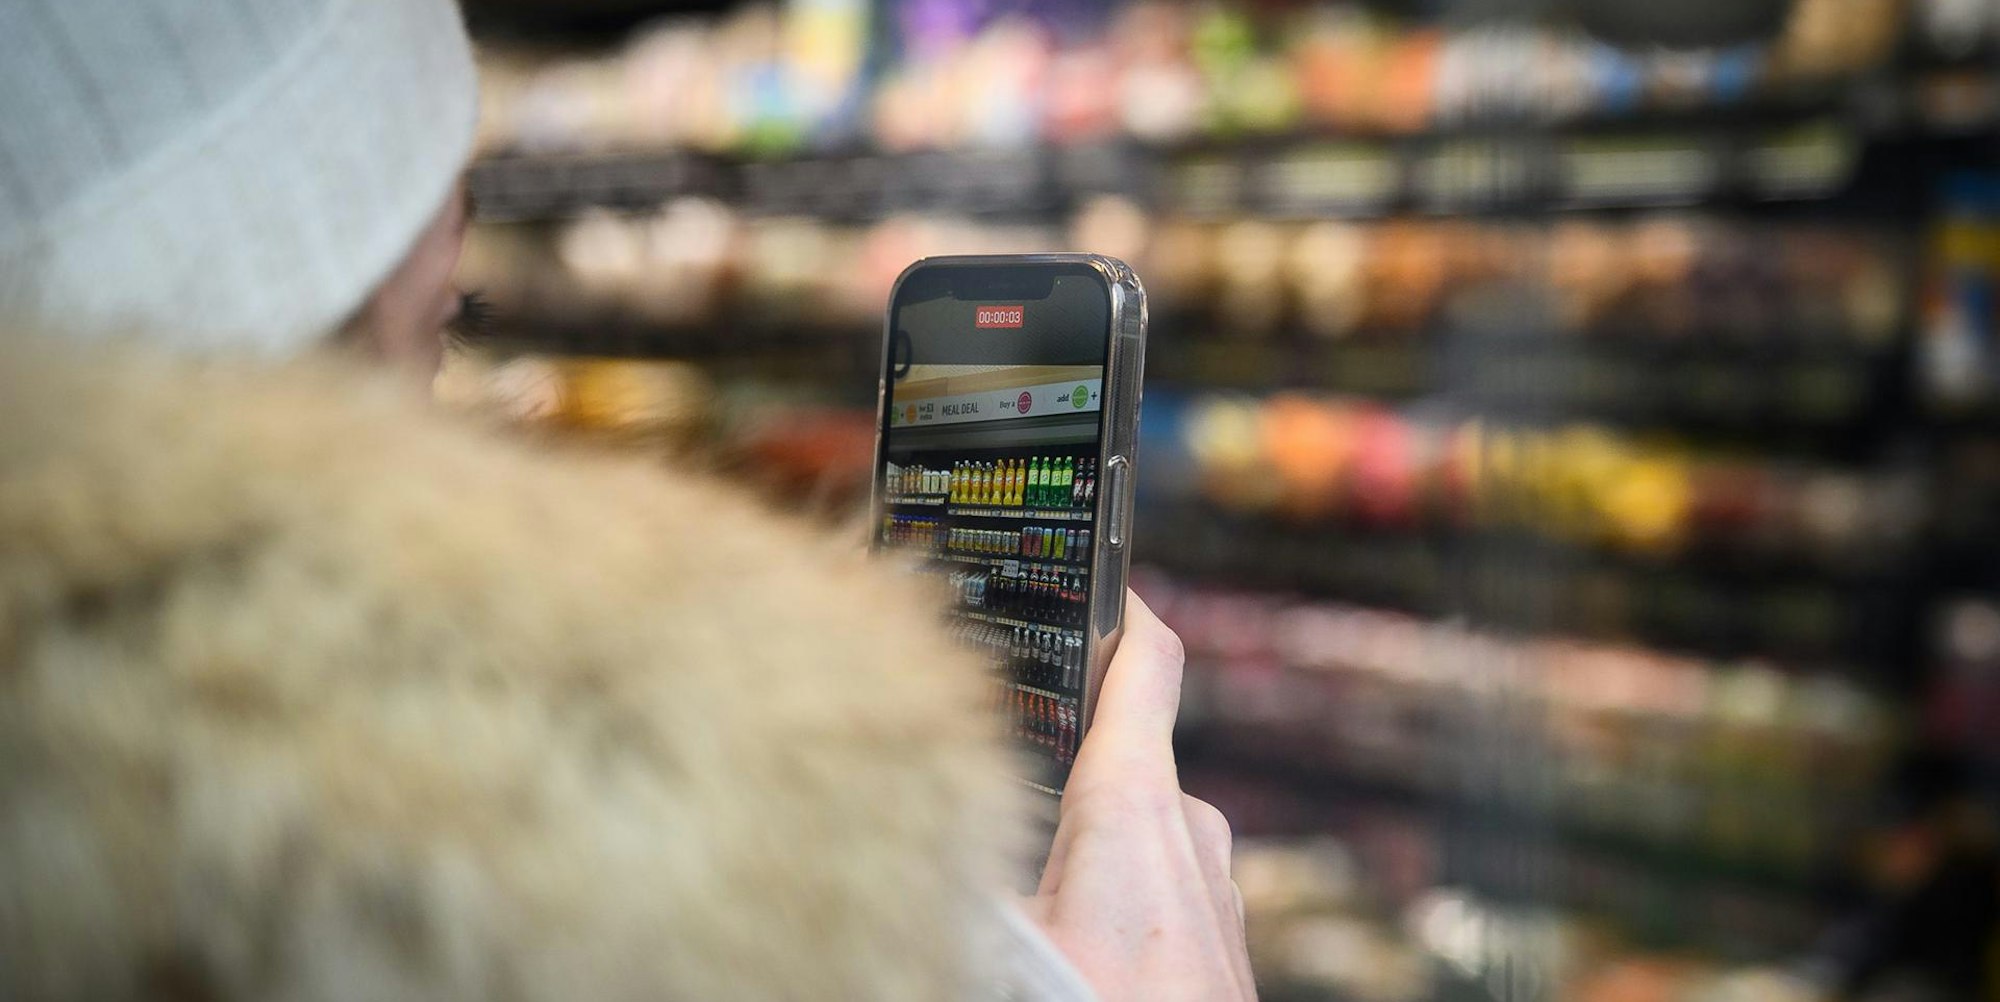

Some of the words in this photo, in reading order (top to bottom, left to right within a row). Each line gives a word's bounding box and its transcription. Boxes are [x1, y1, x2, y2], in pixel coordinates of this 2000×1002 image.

[978, 311, 1021, 324] 00:00:03
[1056, 394, 1070, 403] add
[942, 404, 960, 417] MEAL
[961, 401, 980, 415] DEAL
